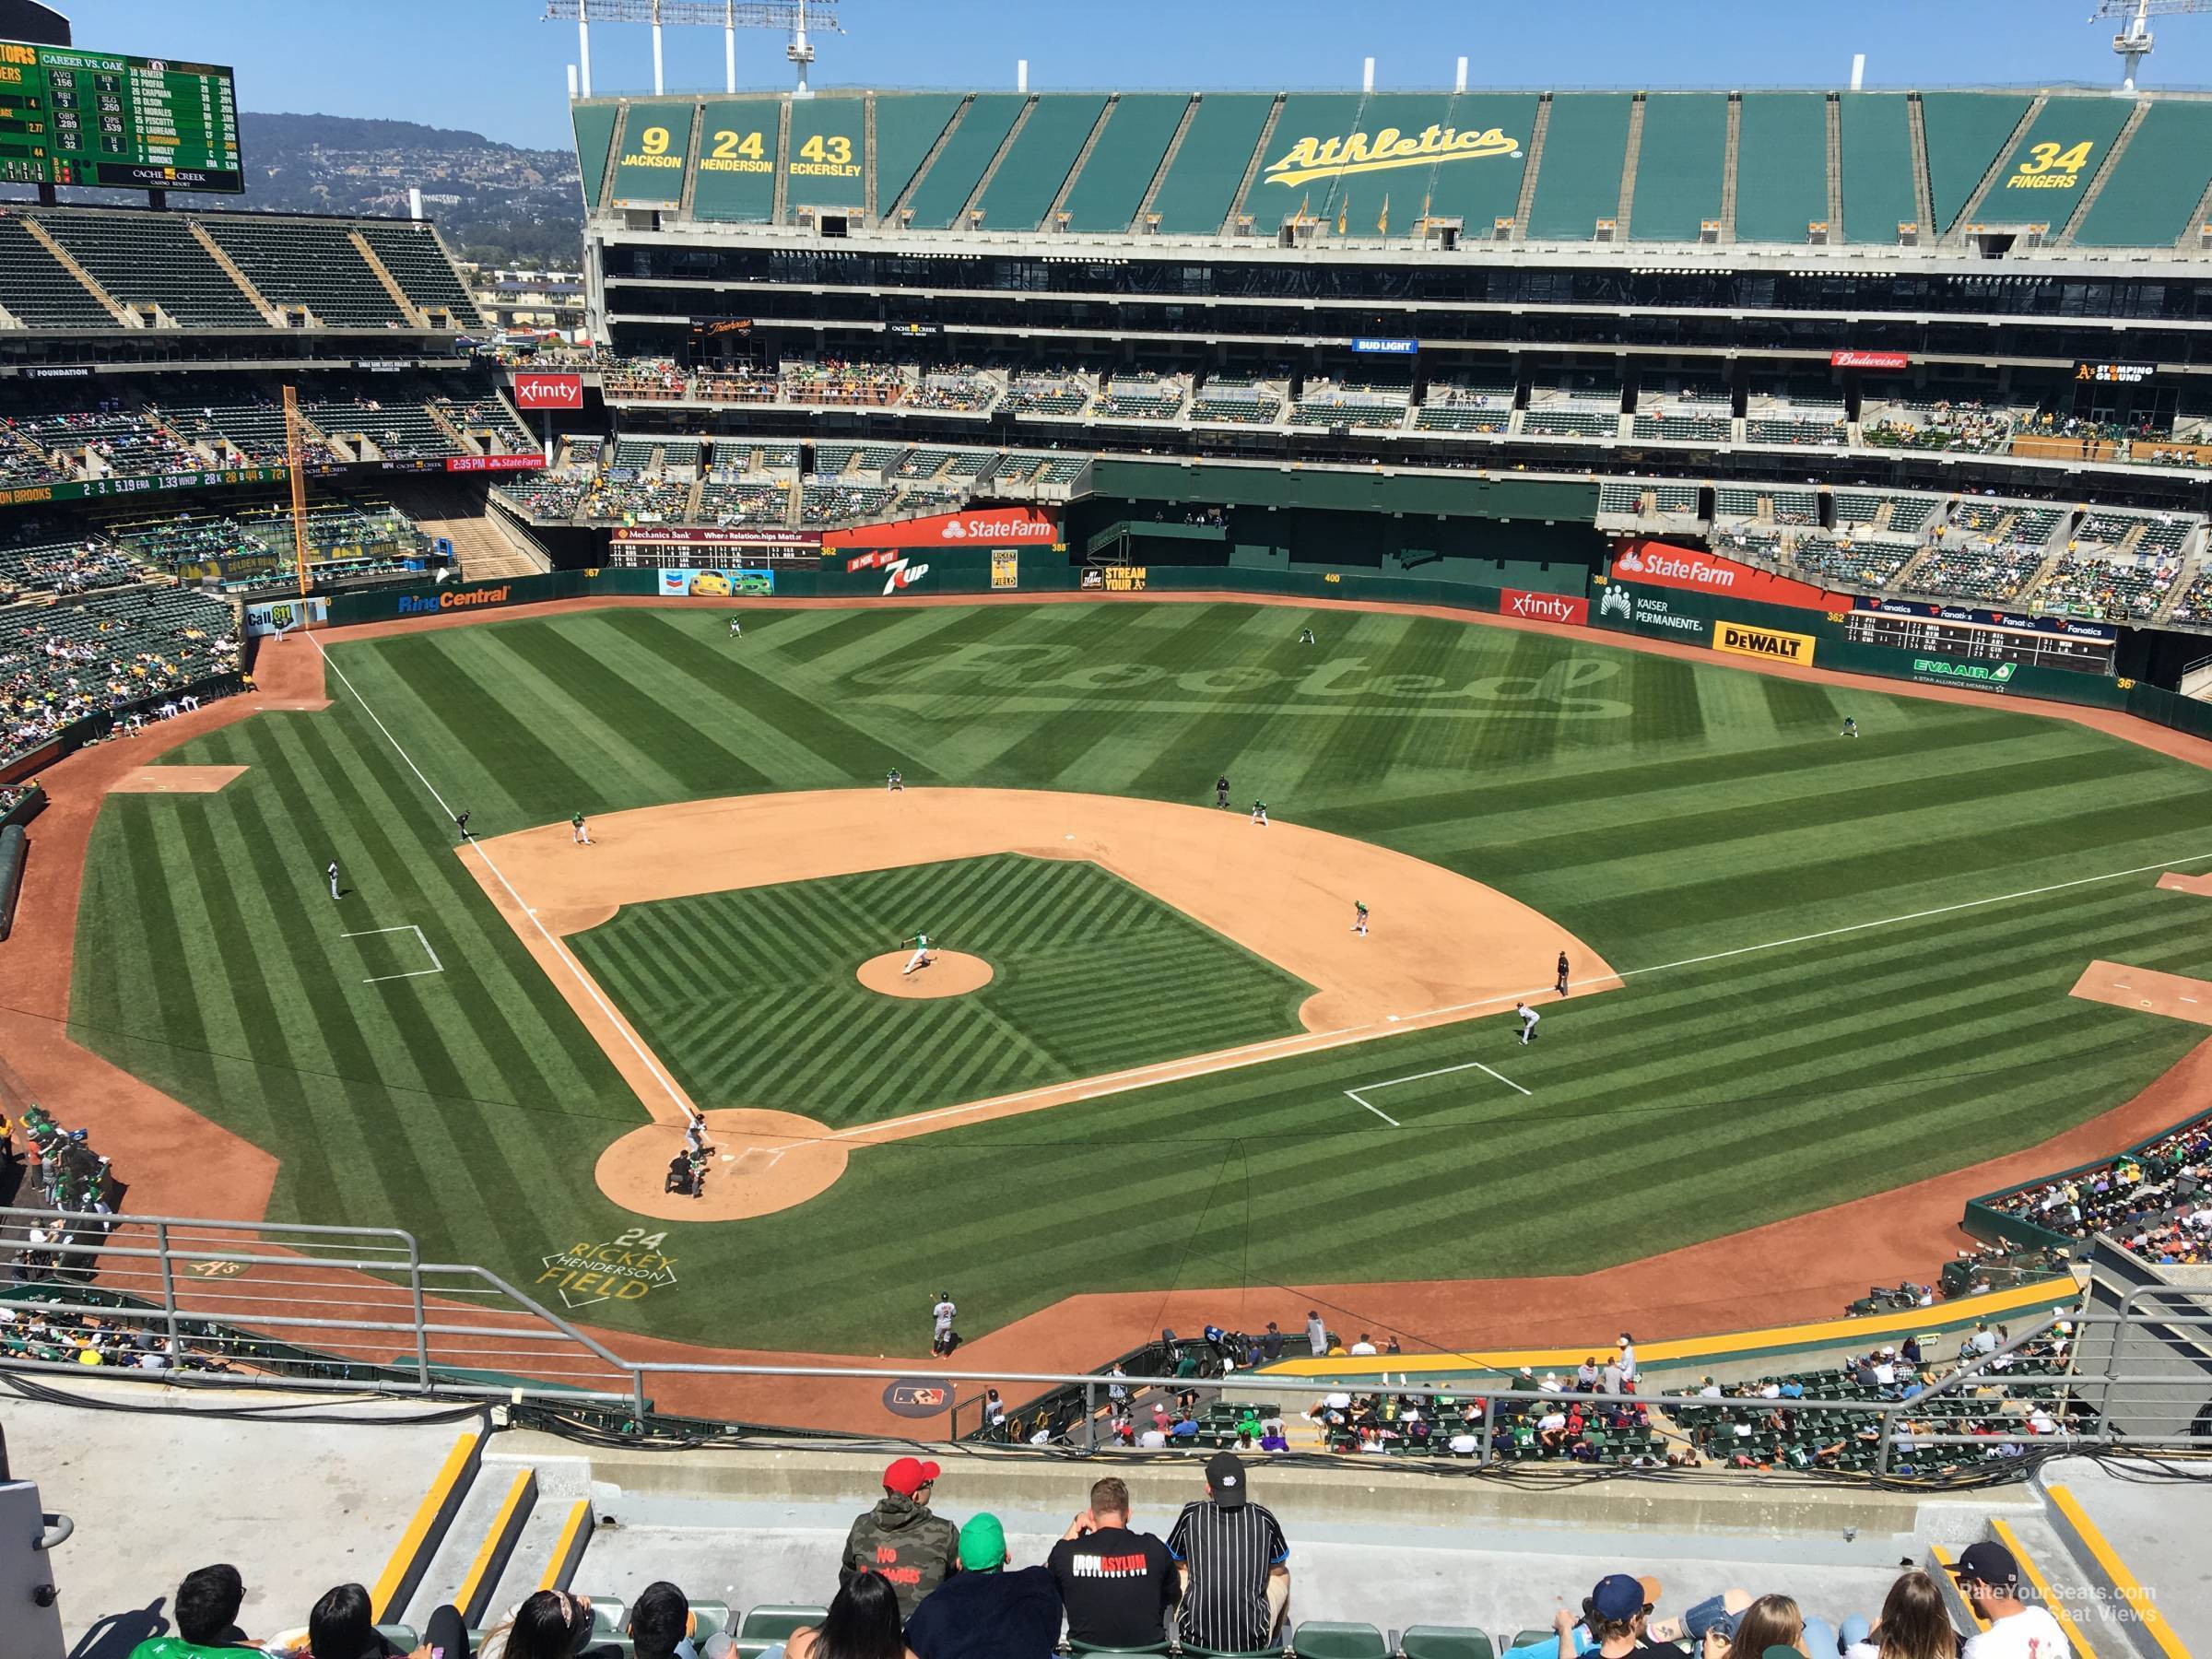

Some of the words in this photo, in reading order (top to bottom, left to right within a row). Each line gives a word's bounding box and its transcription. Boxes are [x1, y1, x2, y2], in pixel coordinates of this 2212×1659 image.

[43, 54, 83, 67] CAREER
[85, 60, 100, 68] VS.
[102, 61, 123, 71] OAK
[54, 78, 73, 87] .156
[59, 120, 77, 129] .289
[65, 141, 76, 149] 32
[642, 127, 670, 154] 9
[712, 131, 764, 159] 24
[800, 135, 852, 164] 43
[1264, 124, 1518, 177] Athletics
[2019, 141, 2094, 174] 34
[621, 154, 682, 168] JACKSON
[700, 159, 773, 173] HENDERSON
[790, 163, 862, 177] ECKERSLEY
[133, 169, 164, 179] CACHE
[176, 172, 206, 182] CREEK
[2006, 175, 2078, 188] FINGERS
[1359, 341, 1380, 350] BUD
[1381, 342, 1412, 351] LIGHT
[1835, 352, 1904, 368] Budweiser
[37, 369, 88, 377] FOUNDATION
[520, 381, 578, 402] xfinity
[453, 459, 473, 470] 2:35
[472, 458, 486, 469] PM
[14, 487, 52, 502] BROOKS
[115, 480, 135, 493] 5.19
[135, 480, 150, 490] ERA
[159, 476, 178, 489] 1.33
[178, 476, 198, 486] WHIP
[629, 530, 670, 540] Mechanics
[820, 547, 836, 556] 362
[1052, 543, 1067, 553] 388
[1106, 567, 1147, 579] STREAM
[1324, 572, 1341, 583] 400
[993, 577, 1016, 586] FIELD
[1106, 579, 1132, 590] YOUR
[1593, 575, 1608, 586] 388
[398, 586, 508, 613] RingCentral
[1637, 597, 1668, 613] KAISER
[1512, 595, 1575, 622] xfinity
[248, 611, 271, 626] Call
[272, 605, 292, 621] 811
[1827, 611, 1844, 624] 362
[2067, 624, 2102, 636] Fanatics
[1913, 659, 1953, 675] EVA
[1953, 665, 1989, 680] AIR
[1935, 678, 1965, 687] ALLIANCE
[1966, 682, 1994, 691] MEMBER
[613, 1228, 668, 1250] 24
[569, 1242, 679, 1271] RICKEY
[556, 1255, 666, 1282] HENDERSON
[535, 1266, 649, 1300] FIELD
[1521, 1434, 1534, 1446] 24
[877, 1547, 897, 1564] NO
